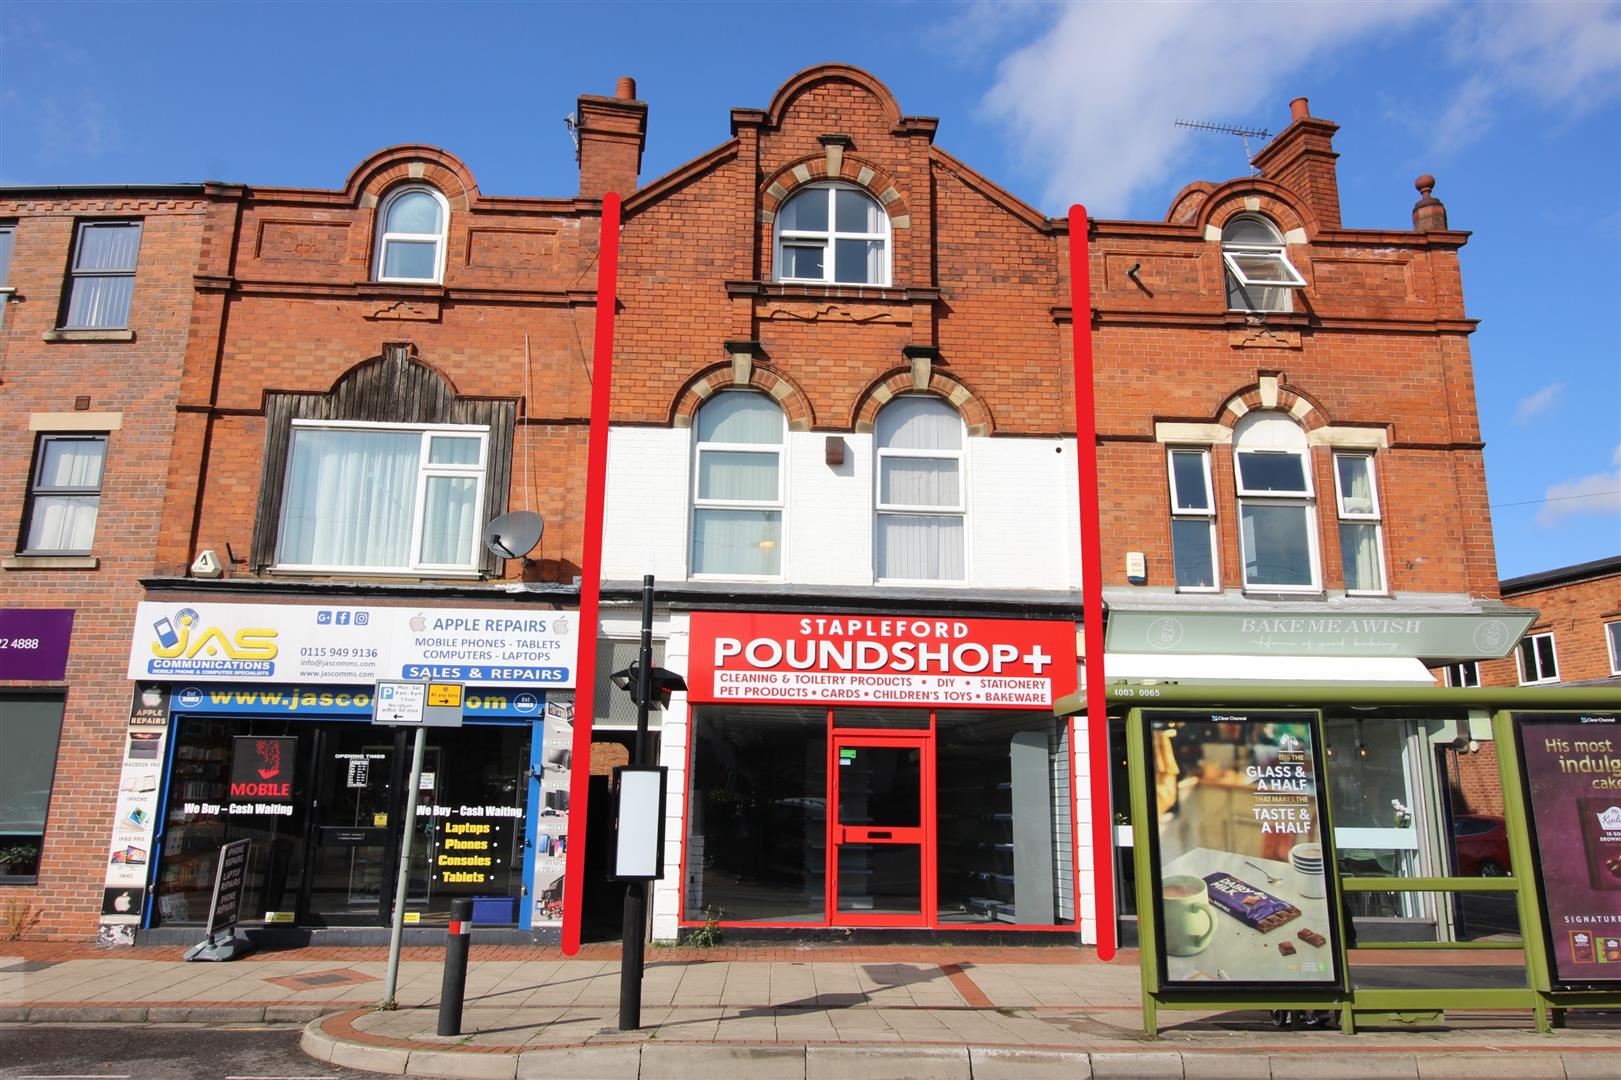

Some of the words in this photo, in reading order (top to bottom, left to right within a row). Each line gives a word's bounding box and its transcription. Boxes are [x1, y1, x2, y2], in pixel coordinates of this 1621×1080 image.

[433, 618, 480, 632] APPLE
[485, 619, 546, 632] REPAIRS
[800, 618, 969, 638] STAPLEFORD
[1241, 618, 1303, 633] BAKE
[1307, 619, 1341, 633] ME
[11, 638, 39, 649] 4888
[415, 637, 458, 647] MOBILE
[461, 638, 506, 648] PHONES
[516, 639, 560, 649] TABLETS
[300, 647, 326, 657] 0115
[329, 648, 349, 657] 949
[352, 648, 378, 658] 9136
[423, 649, 492, 660] COMPUTERS
[502, 651, 551, 661] LAPTOPS
[714, 637, 1052, 674] POUNDSHOP+
[153, 660, 270, 670] COMMUNICATIONS
[300, 659, 376, 668] info@jascomms.com
[300, 669, 375, 678] www.jascomms.com
[409, 666, 461, 679] SALES
[469, 667, 482, 679] &
[491, 668, 562, 680] REPAIRS
[720, 673, 777, 684] CLEANING
[782, 674, 790, 684] &
[795, 674, 845, 685] TOILETRY
[850, 676, 912, 687] PRODUCTS
[937, 678, 955, 688] DIY
[980, 678, 1046, 690] STATIONERY
[383, 688, 393, 698] P
[720, 687, 739, 696] PET
[744, 687, 808, 697] PRODUCTS
[821, 689, 861, 698] CARDS
[873, 689, 939, 701] CHILDREN'S
[944, 691, 972, 701] TOYS
[985, 692, 1046, 702] BAKEWARE
[131, 717, 166, 725] REPAIRS
[1545, 739, 1569, 753] His
[1574, 739, 1613, 753] most
[1246, 766, 1292, 778] GLASS
[1295, 767, 1306, 778] &
[230, 783, 290, 797] MOBILE
[1257, 779, 1268, 791] A
[1271, 779, 1307, 791] HALF
[183, 803, 200, 814] We
[201, 803, 221, 815] Buy
[228, 804, 253, 814] Cash
[254, 804, 293, 816] Waiting
[416, 805, 432, 816] We
[432, 805, 452, 817] Buy
[460, 806, 484, 817] Cash
[485, 806, 523, 818] Waiting
[1252, 809, 1295, 820] TASTE
[1299, 809, 1310, 820] &
[445, 822, 490, 834] Laptops
[1261, 822, 1272, 834] A
[1275, 822, 1311, 834] HALF
[444, 838, 488, 849] Phones
[438, 855, 491, 866] Consoles
[442, 871, 485, 883] Tablets
